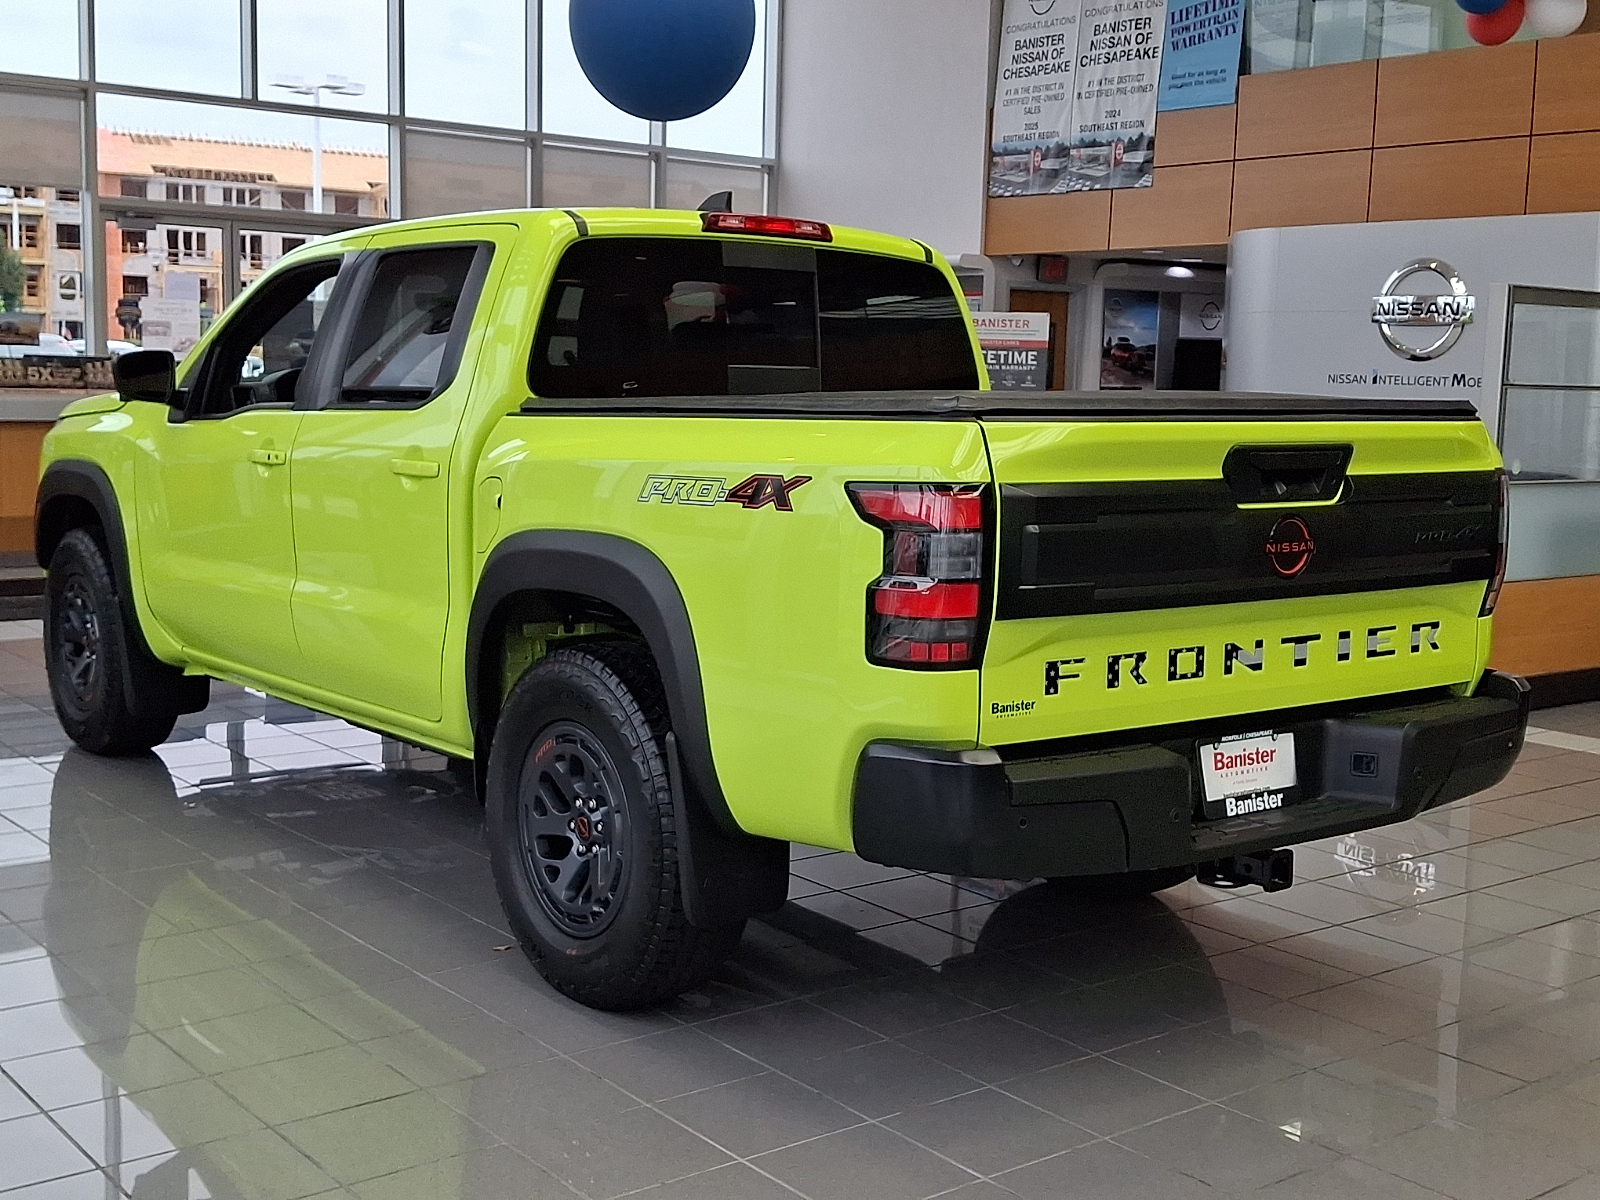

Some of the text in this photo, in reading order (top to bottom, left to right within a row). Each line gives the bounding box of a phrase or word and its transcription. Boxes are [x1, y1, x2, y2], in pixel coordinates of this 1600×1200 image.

[1083, 0, 1164, 17] CONGRATULATIONS
[1006, 15, 1077, 34] CONGRATULATIONS
[1093, 17, 1152, 37] BANISTER
[1170, 8, 1239, 39] POWERTRAIN
[1014, 33, 1065, 51] BANISTER
[1089, 31, 1154, 52] NISSAN OF
[1171, 21, 1239, 52] WARRANTY
[1011, 47, 1066, 65] NISSAN OF
[1080, 46, 1160, 68] CHESAPEAKE
[1003, 60, 1071, 80] CHESAPEAKE
[1020, 85, 1031, 94] THE
[1032, 82, 1057, 93] DISTRICT
[1104, 76, 1116, 86] THE
[1116, 73, 1146, 85] DISTRICT
[1023, 105, 1041, 115] SALES
[1104, 108, 1122, 119] 2024
[1079, 119, 1145, 134] SOUTHEAST REGION
[1002, 130, 1060, 143] SOUTHEAST REGION
[1377, 302, 1461, 318] NISSAN
[972, 318, 1030, 328] BANISTER
[1327, 374, 1367, 385] NISSAN
[1371, 369, 1449, 388] INTELLIGENT
[637, 474, 813, 512] PRO-4X
[1266, 540, 1314, 553] NISSAN
[1045, 621, 1440, 695] FRONTIER
[991, 700, 1036, 714] Banister
[1246, 729, 1273, 738] CHESAPEAKE
[1213, 747, 1277, 771] Banister
[1220, 765, 1268, 778] AUTOMOTIVE
[1225, 791, 1284, 816] Banister
